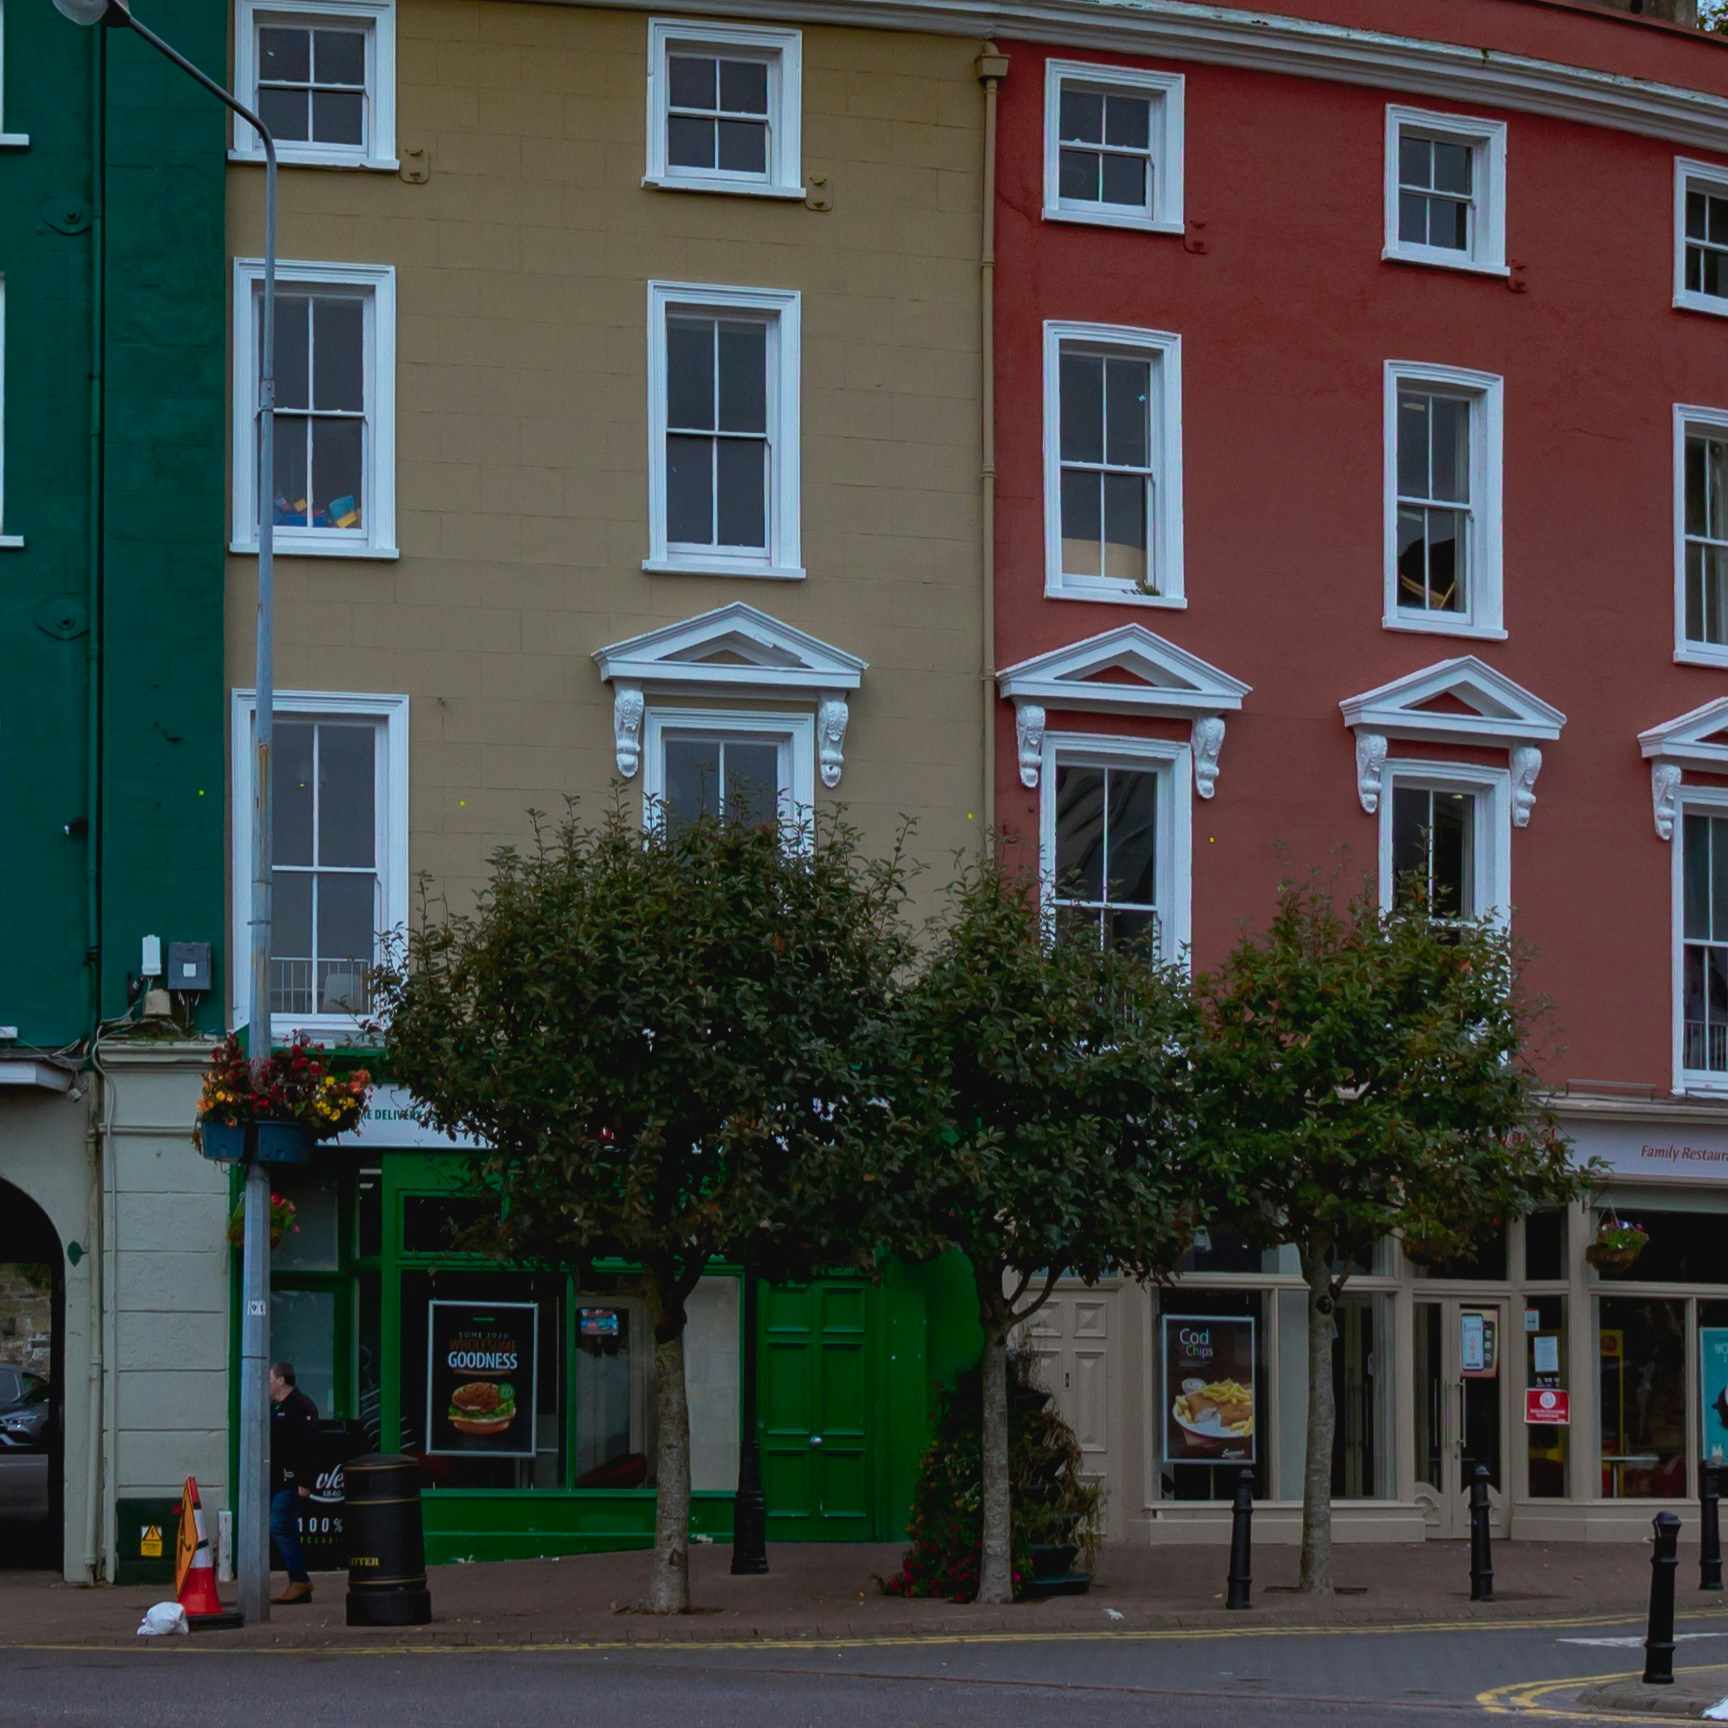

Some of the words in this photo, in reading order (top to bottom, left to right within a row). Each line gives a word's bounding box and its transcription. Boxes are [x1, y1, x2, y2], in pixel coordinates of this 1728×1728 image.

[1640, 1144, 1679, 1163] Family
[1179, 1328, 1209, 1344] Cod
[1185, 1344, 1214, 1359] Chips
[448, 1351, 518, 1370] GOODNESS
[296, 1517, 344, 1533] 100%
